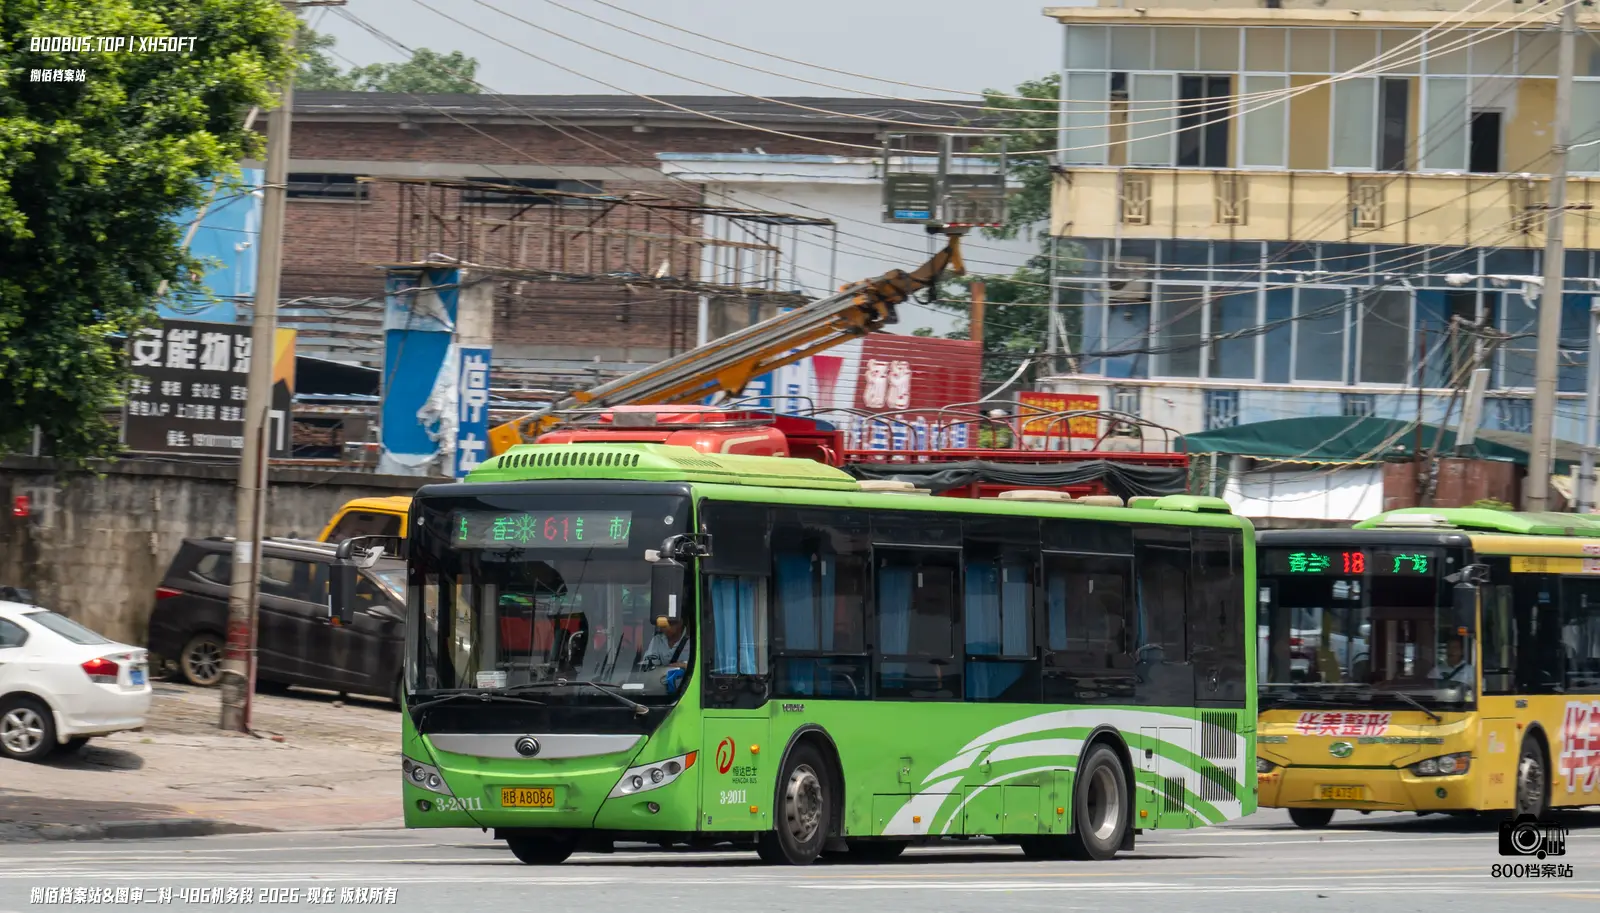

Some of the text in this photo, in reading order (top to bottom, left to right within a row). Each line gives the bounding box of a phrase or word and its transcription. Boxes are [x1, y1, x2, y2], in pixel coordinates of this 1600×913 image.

[543, 517, 570, 542] 61
[1342, 552, 1365, 573] 18
[1296, 712, 1390, 736] 华美整形
[733, 766, 758, 776] 恒达巴士
[435, 796, 484, 812] 3-2011
[720, 789, 747, 804] 3-2011
